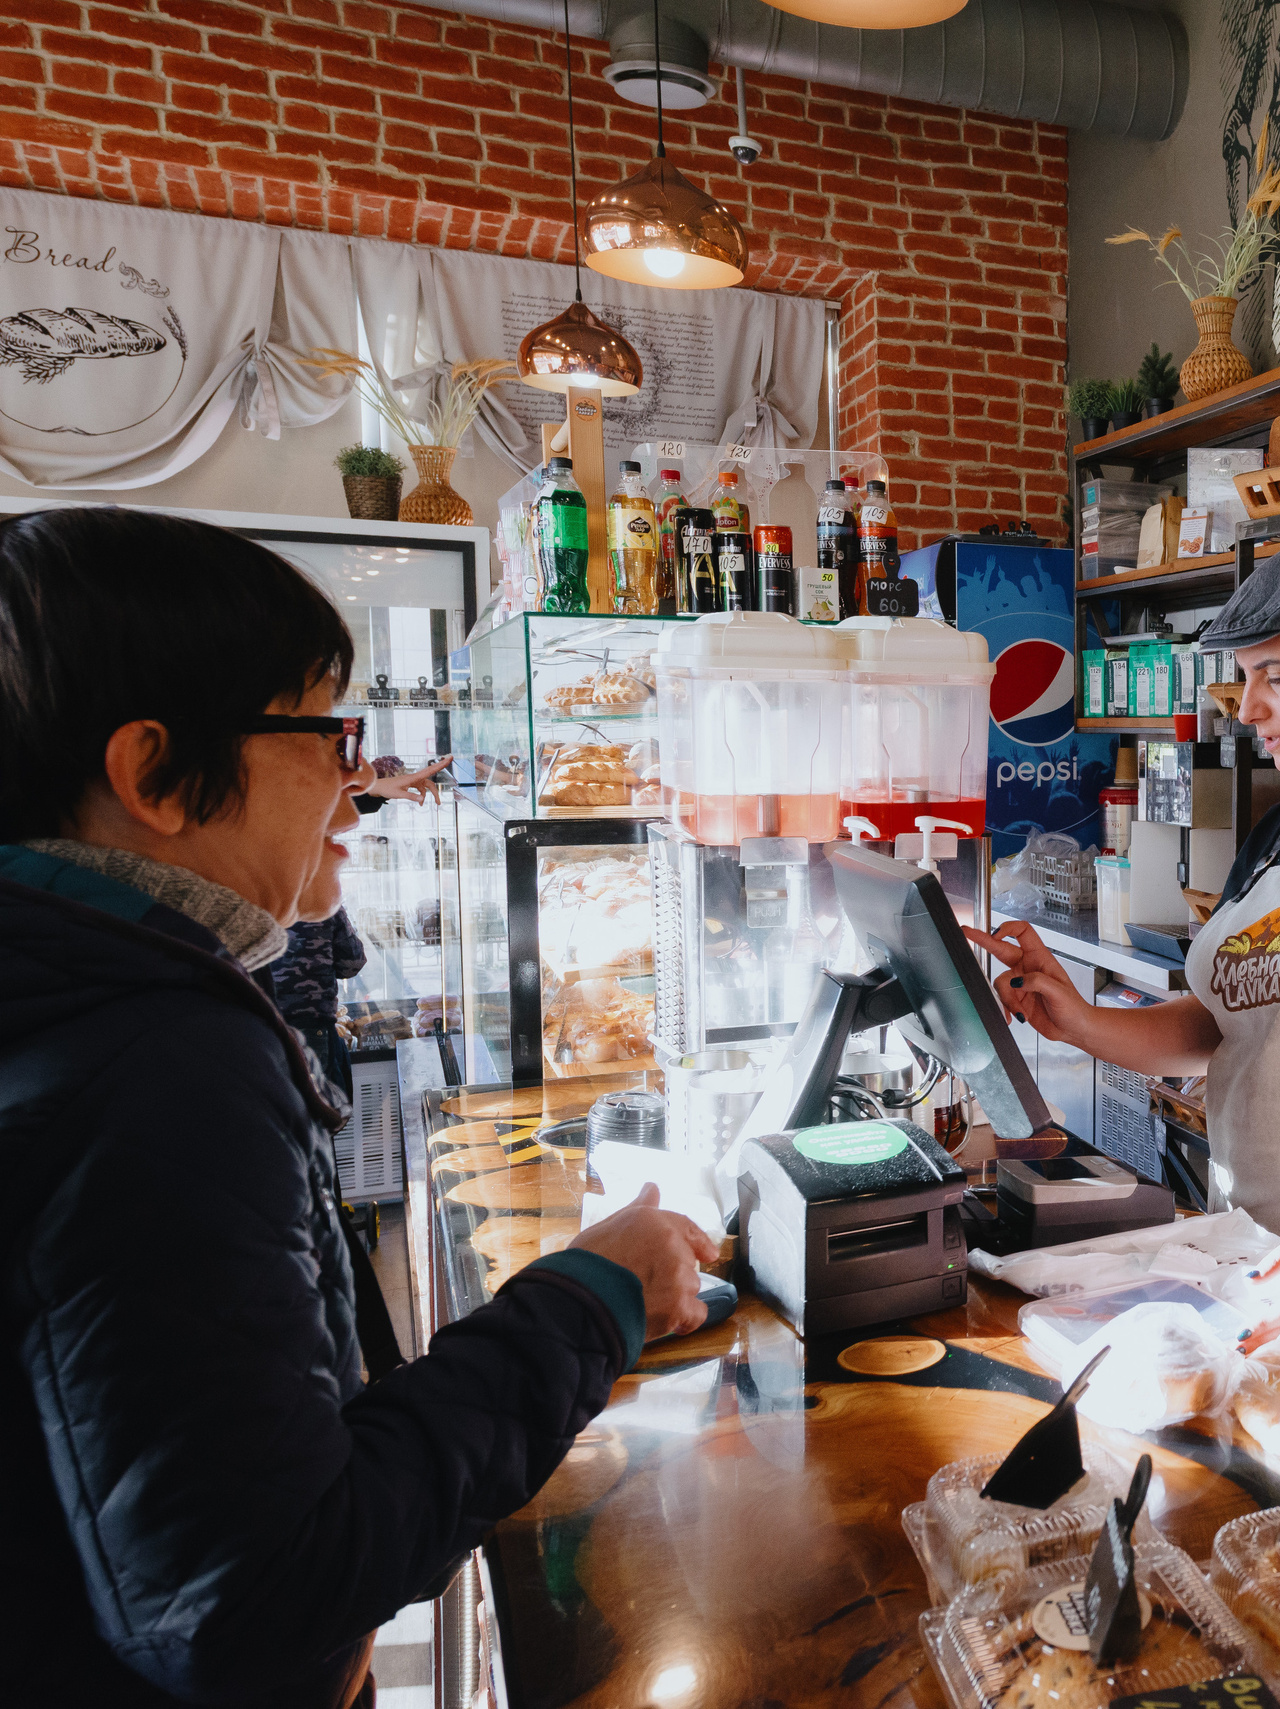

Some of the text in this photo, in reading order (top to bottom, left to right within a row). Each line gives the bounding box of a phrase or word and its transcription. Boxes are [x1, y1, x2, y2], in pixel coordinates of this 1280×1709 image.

[4, 226, 117, 273] Bread
[661, 442, 682, 456] 120
[730, 445, 752, 459] 120
[821, 507, 843, 520] 105
[865, 507, 887, 520] 105
[685, 537, 709, 552] 170
[860, 541, 887, 550] EVERVESS
[759, 557, 791, 569] EVERVESS
[822, 573, 833, 581] 50
[871, 581, 902, 592] МОРС
[997, 756, 1079, 788] pepsi
[754, 906, 781, 917] PUSH
[1225, 973, 1280, 1008] LAVKA
